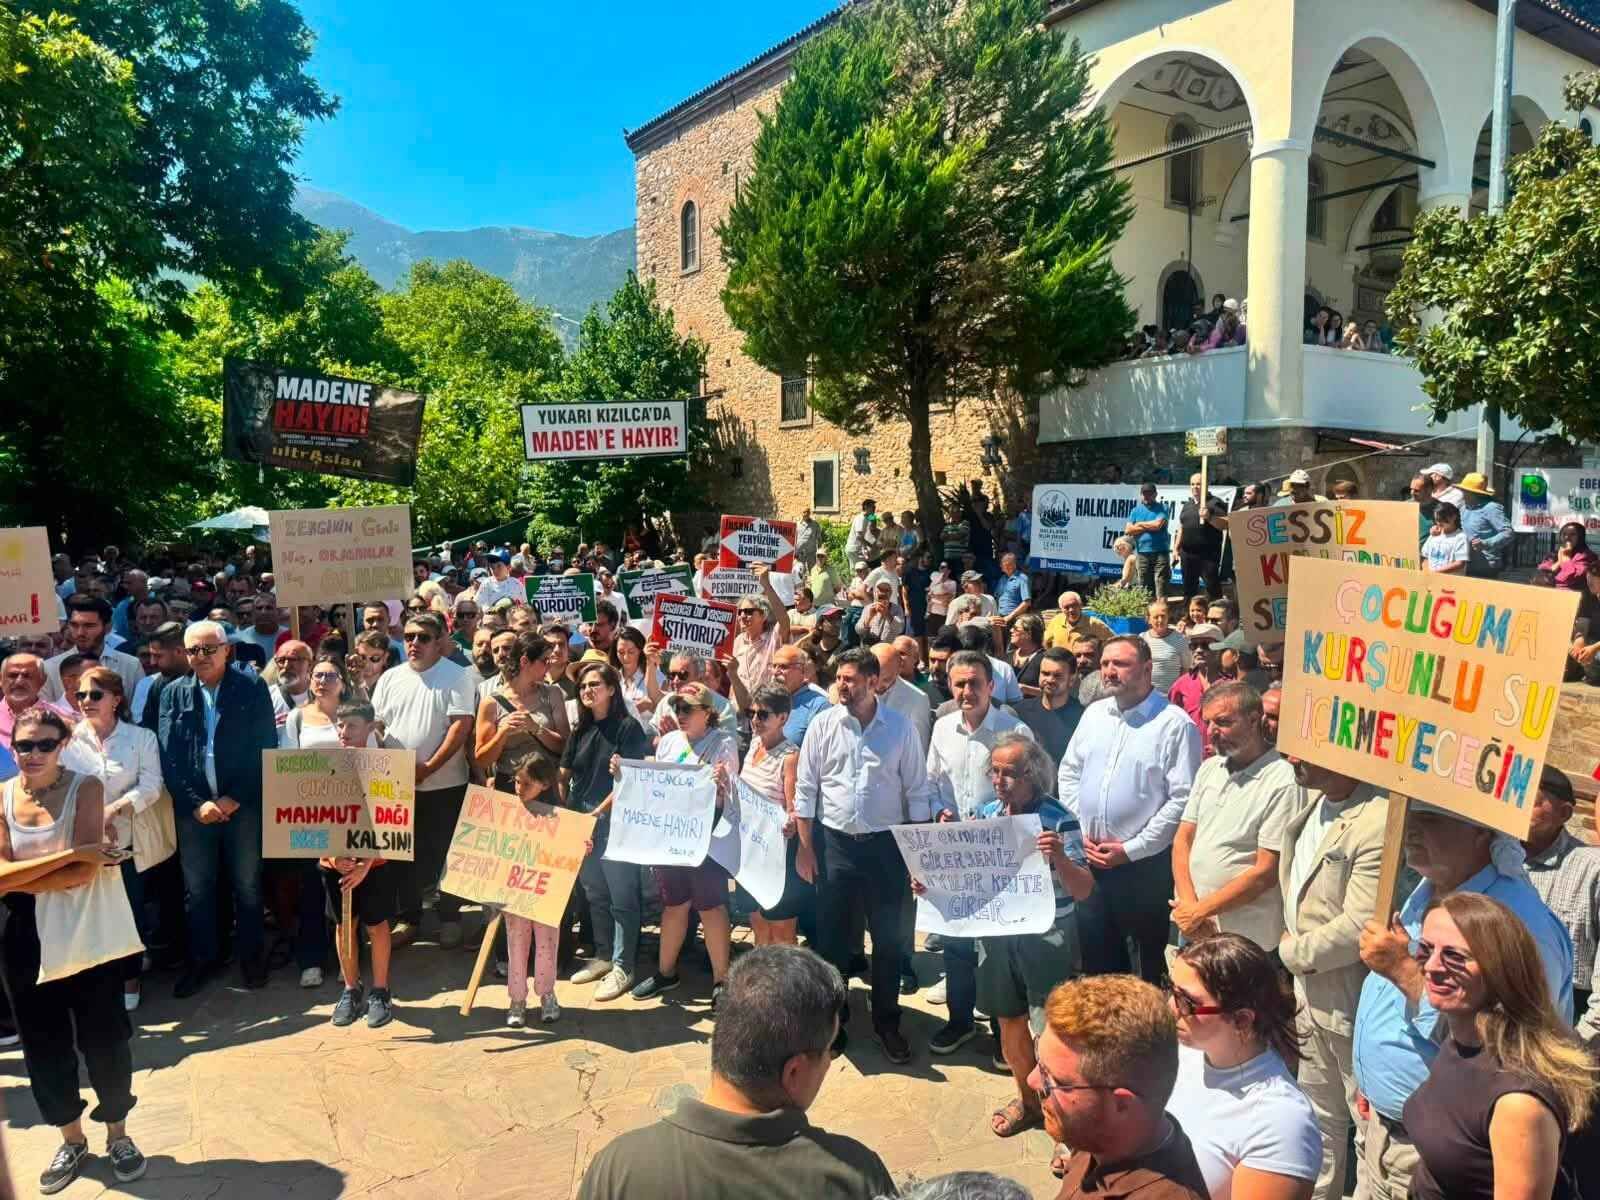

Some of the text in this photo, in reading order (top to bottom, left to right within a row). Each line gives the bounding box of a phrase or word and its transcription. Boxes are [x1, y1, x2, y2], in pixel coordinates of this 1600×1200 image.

[276, 375, 373, 407] MADENE
[273, 399, 369, 434] HAYIR!
[537, 406, 672, 425] YUKARI KIZILCA'DA
[532, 426, 680, 453] MADEN'E HAYIR!
[1246, 505, 1367, 547] SESSİZ
[738, 534, 780, 547] YERYÜZÜNE
[532, 597, 589, 613] DURDUR!
[662, 615, 726, 648] İSTİYORUZ!
[1335, 579, 1540, 660] ÇOCUĞUMA
[1302, 629, 1556, 742] KURŞUNLU SU
[1299, 688, 1535, 809] İÇİRMEYECEĞİM
[275, 803, 409, 826] MAHMUT DAĞI
[623, 807, 662, 828] MADENE
[346, 829, 412, 853] KALSIN!
[453, 821, 541, 867] ZENGİN
[902, 827, 1005, 851] SİZ ORMANA
[919, 848, 1019, 871] GİRERSENİZ
[506, 863, 552, 895] BİZE
[992, 873, 1043, 895] KENTE
